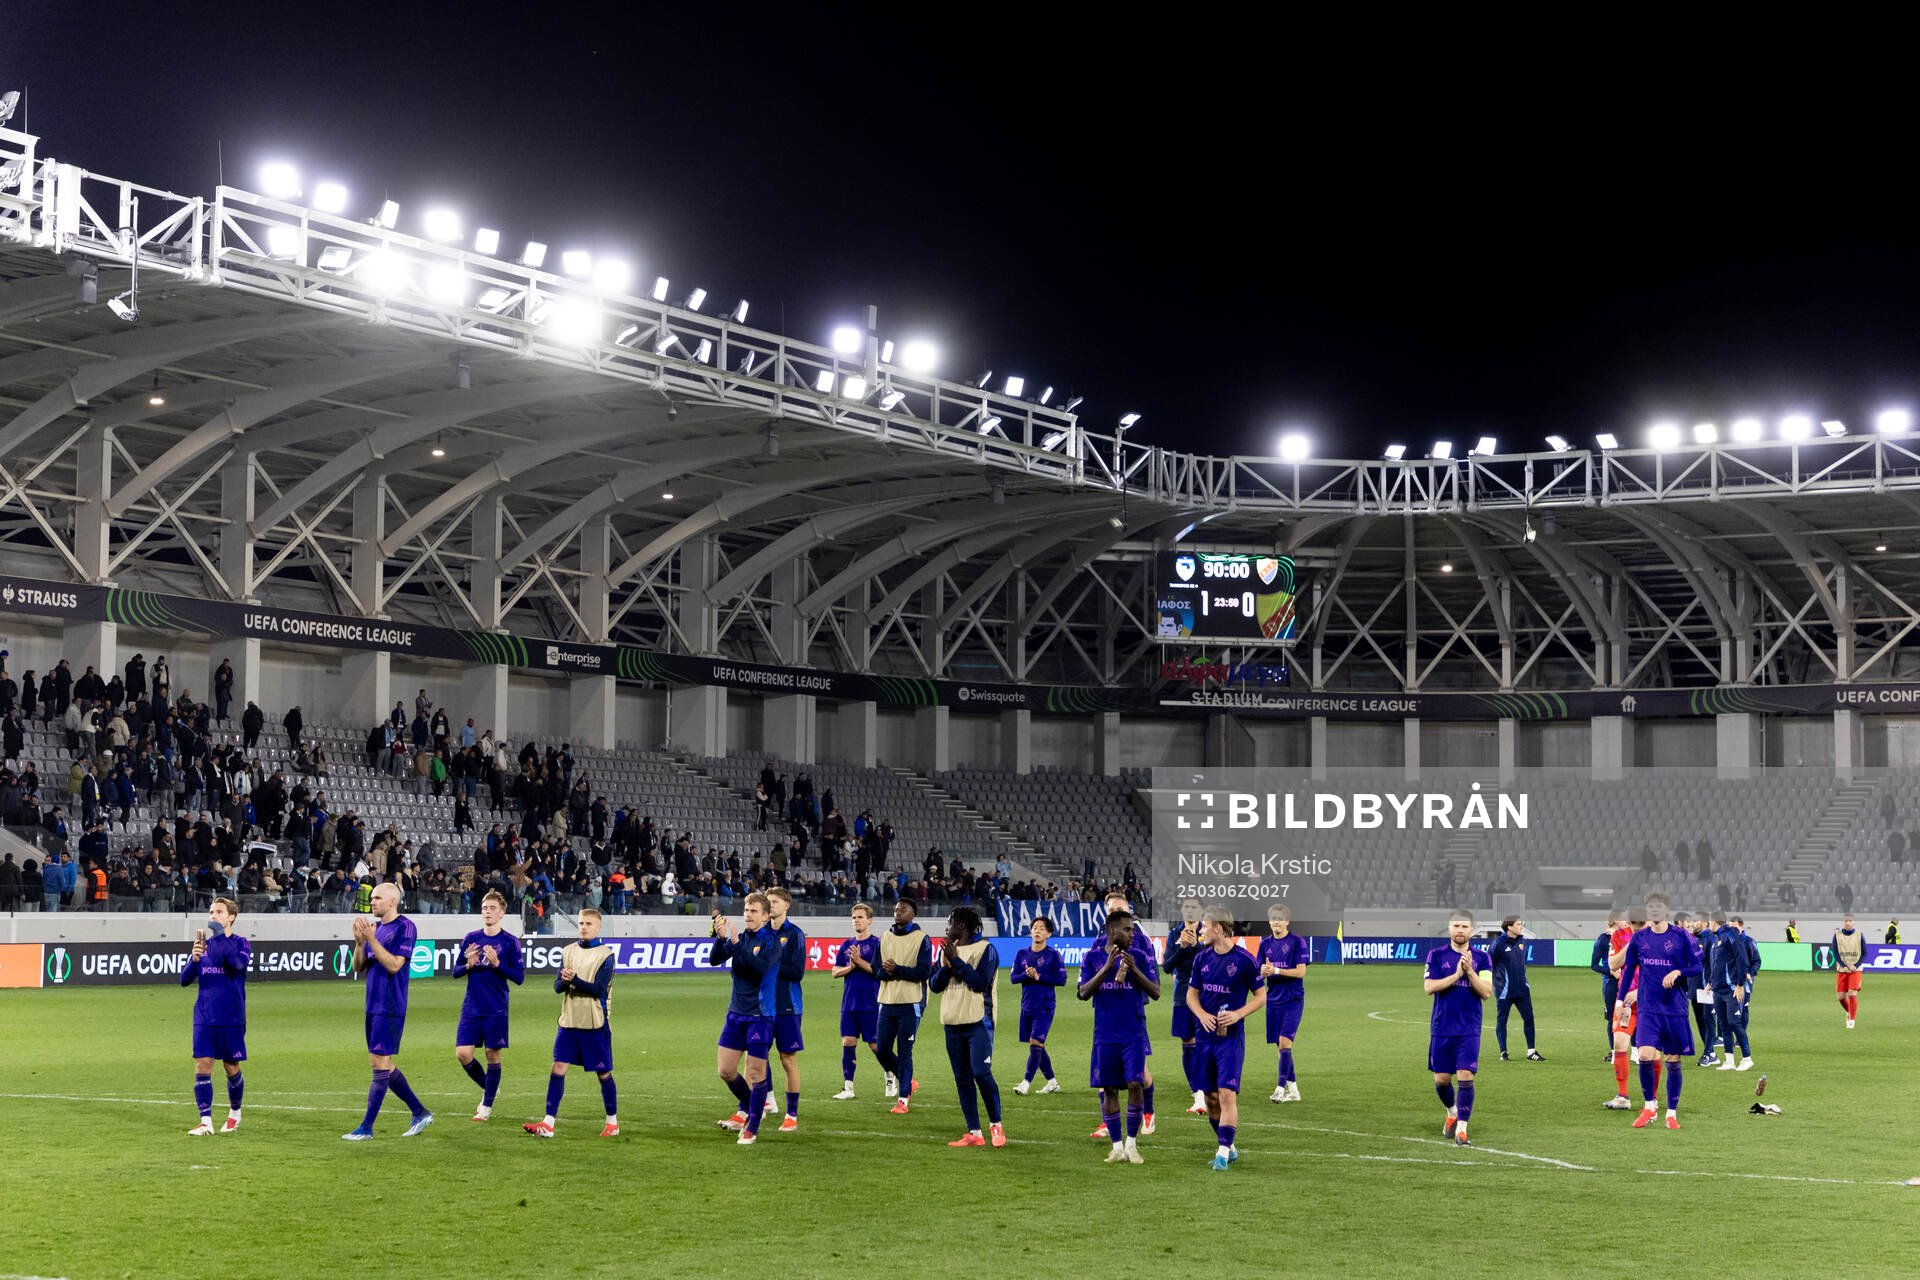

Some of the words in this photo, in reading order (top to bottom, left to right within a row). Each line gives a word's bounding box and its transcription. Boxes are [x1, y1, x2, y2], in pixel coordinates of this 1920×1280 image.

[1203, 562, 1250, 578] 90:00
[17, 588, 77, 608] STRAUSS
[1201, 590, 1209, 616] 1
[1242, 592, 1255, 617] 0
[244, 613, 279, 631] UEFA
[281, 618, 363, 641] CONFERENCE
[366, 627, 412, 646] LEAGUE
[550, 652, 601, 665] enterprise
[713, 666, 737, 680] UEFA
[738, 669, 794, 687] CONFERENCE
[796, 675, 831, 690] LEAGUE
[970, 688, 1026, 704] Swissquote
[1191, 691, 1263, 706] STADIUM
[1836, 690, 1876, 703] UEFA
[1362, 700, 1417, 712] LEAGUE
[1342, 943, 1394, 959] WELCOME
[1394, 943, 1417, 959] ALL
[82, 954, 132, 975] UEFA
[260, 951, 324, 972] LEAGUE
